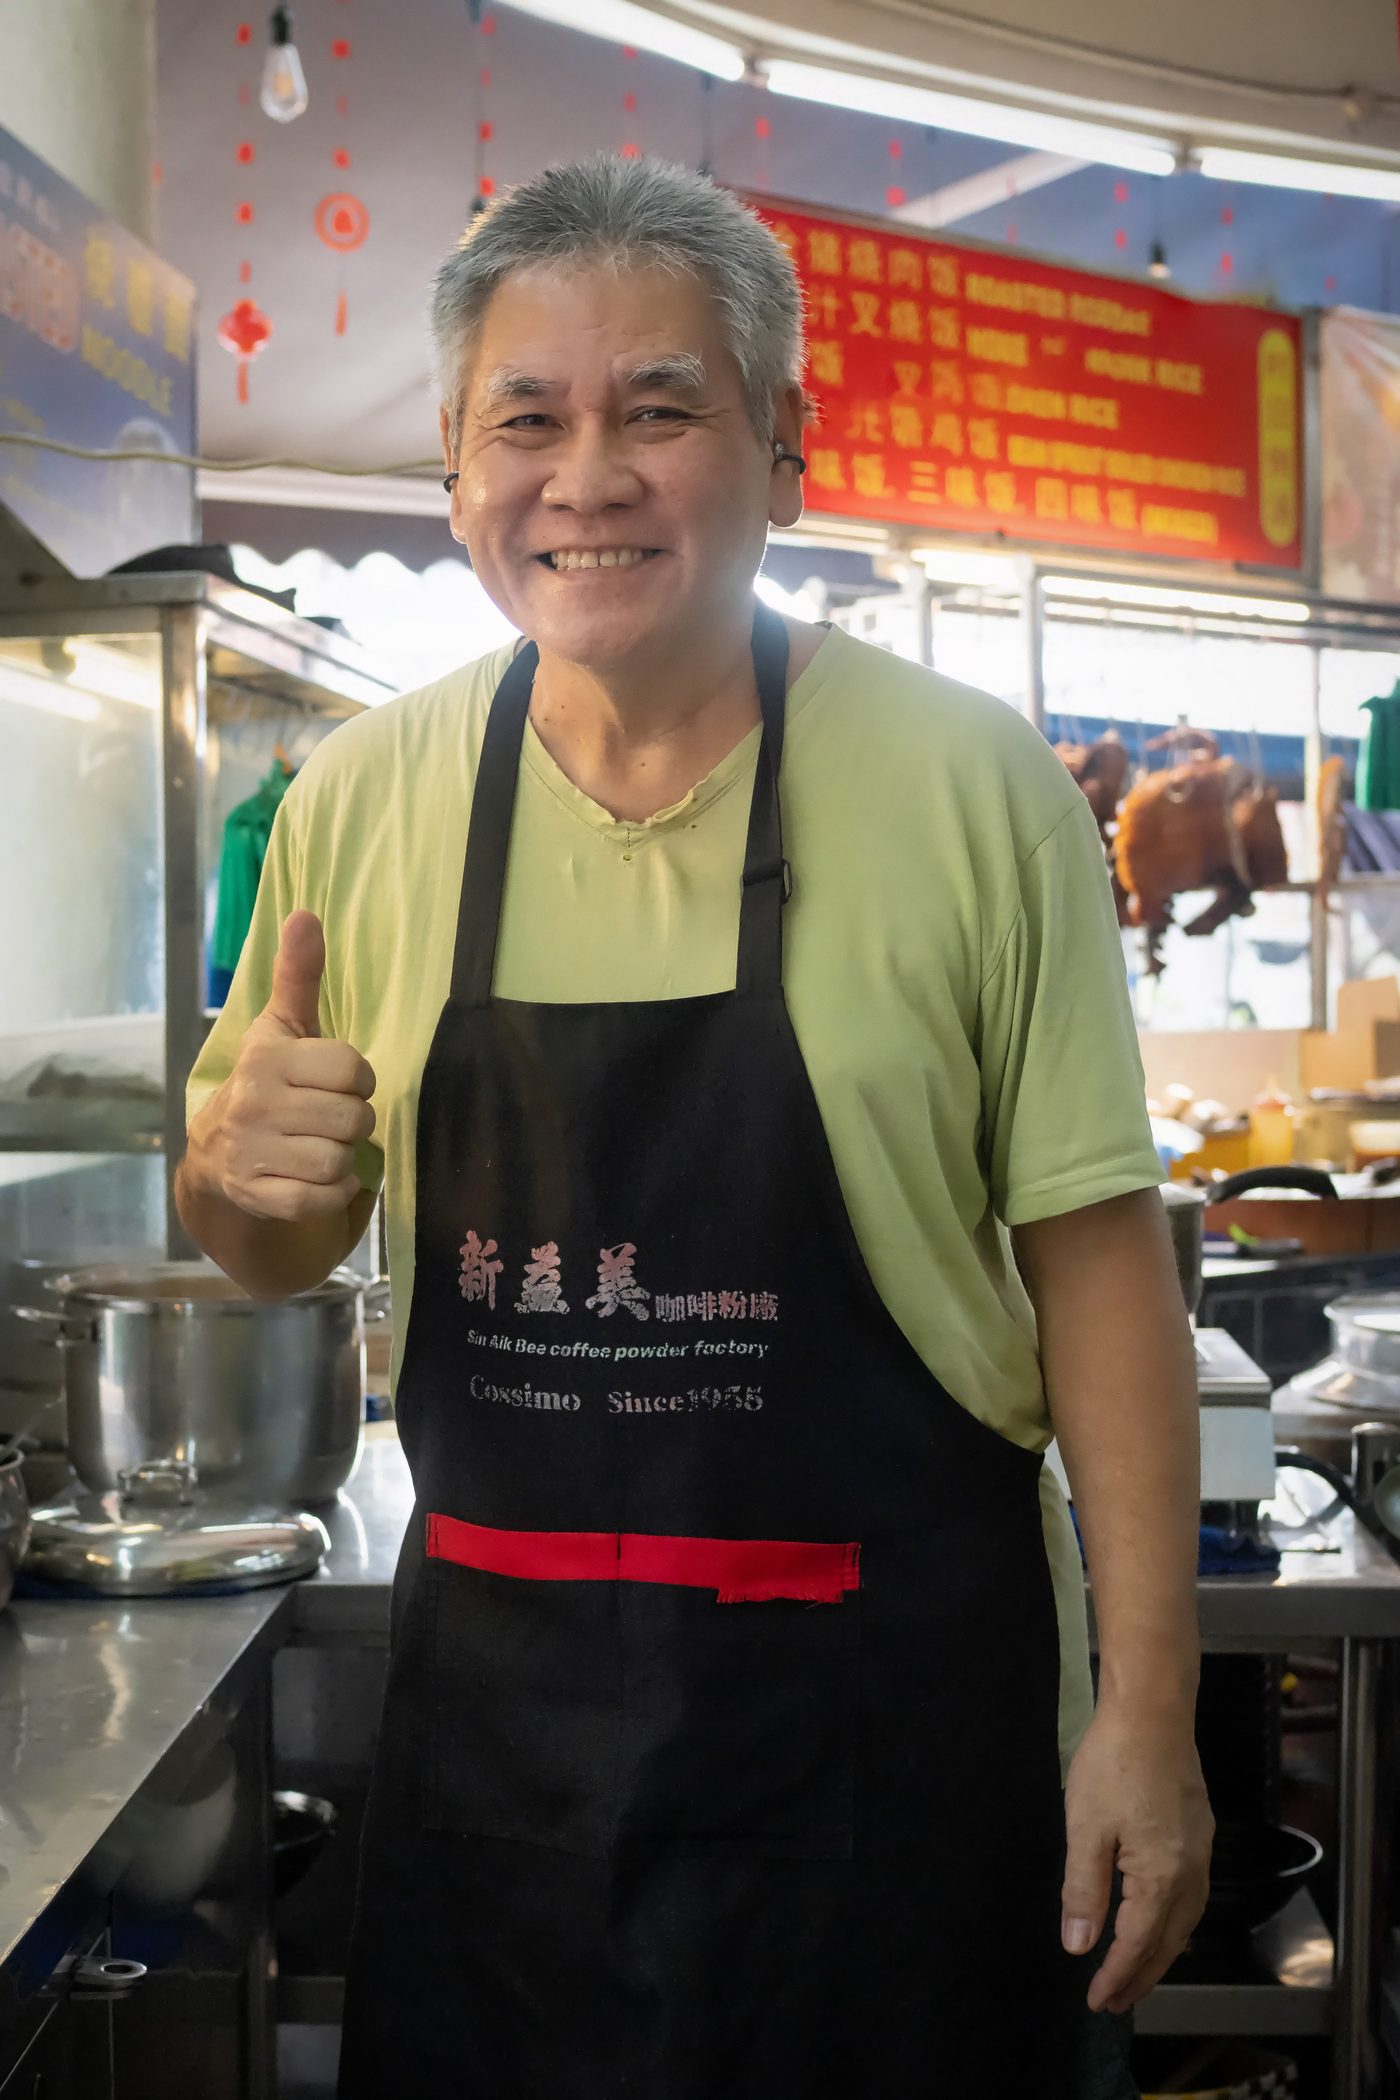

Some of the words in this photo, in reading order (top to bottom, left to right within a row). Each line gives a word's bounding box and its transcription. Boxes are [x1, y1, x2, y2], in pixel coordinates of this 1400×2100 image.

[467, 1329, 487, 1347] Sin
[489, 1334, 513, 1351] Aik
[549, 1342, 612, 1359] coffee
[614, 1342, 689, 1362] powder
[694, 1339, 769, 1359] factory
